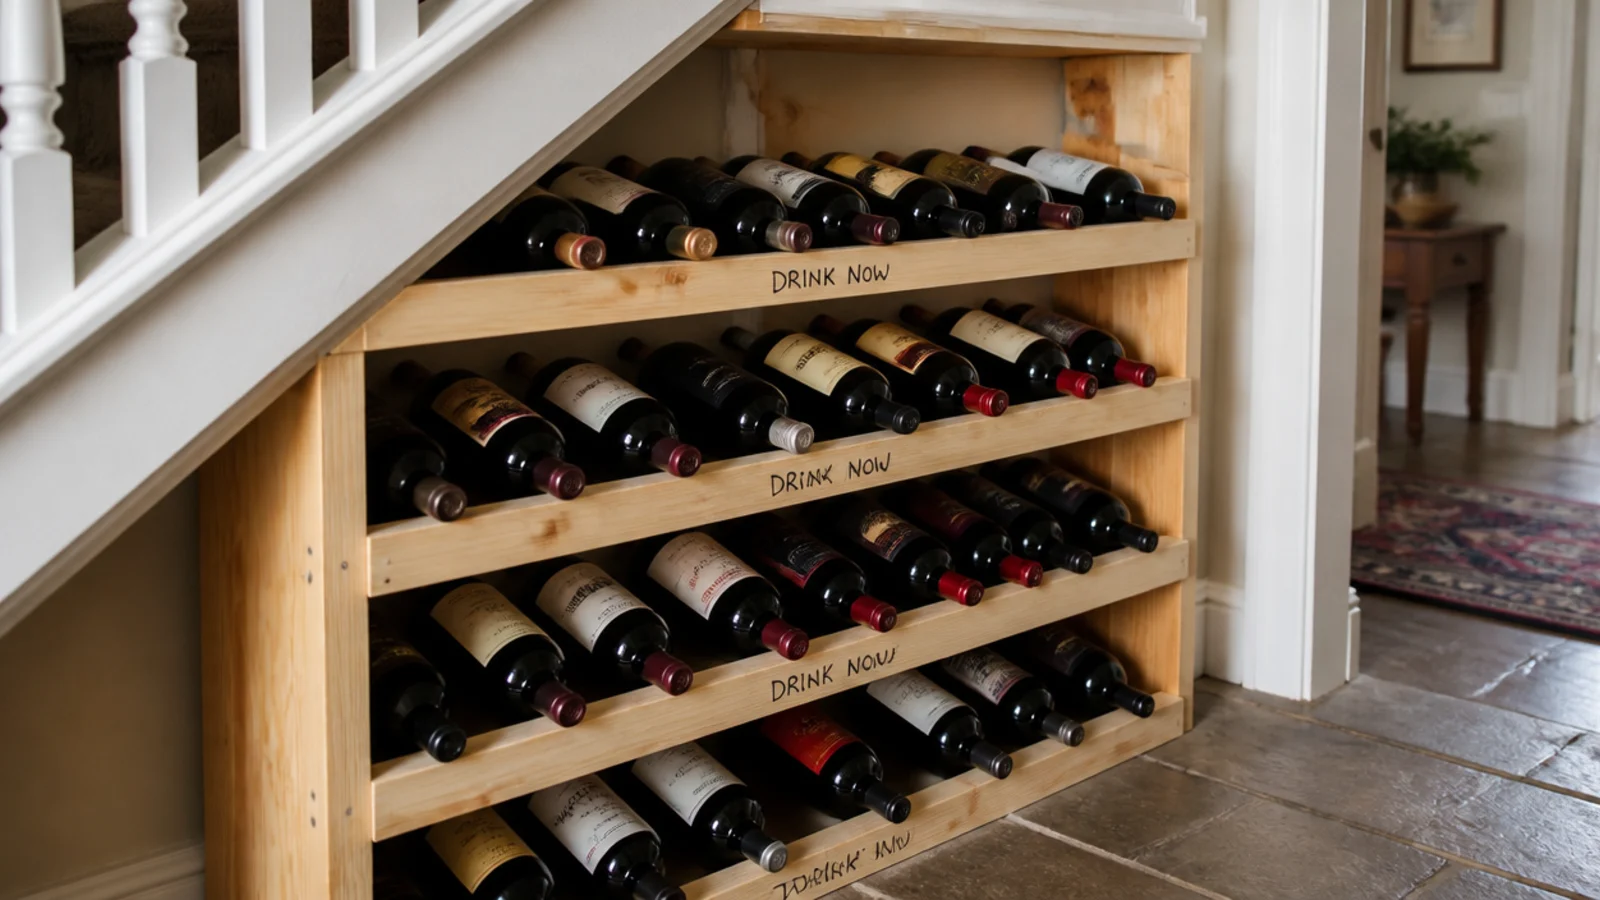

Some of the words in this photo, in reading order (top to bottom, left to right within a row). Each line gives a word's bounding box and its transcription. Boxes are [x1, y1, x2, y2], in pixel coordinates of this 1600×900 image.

[772, 267, 835, 293] DRINK
[848, 264, 890, 284] NOW
[771, 464, 833, 497] DRINK
[849, 452, 891, 479] NOW
[771, 663, 833, 702] DRINK
